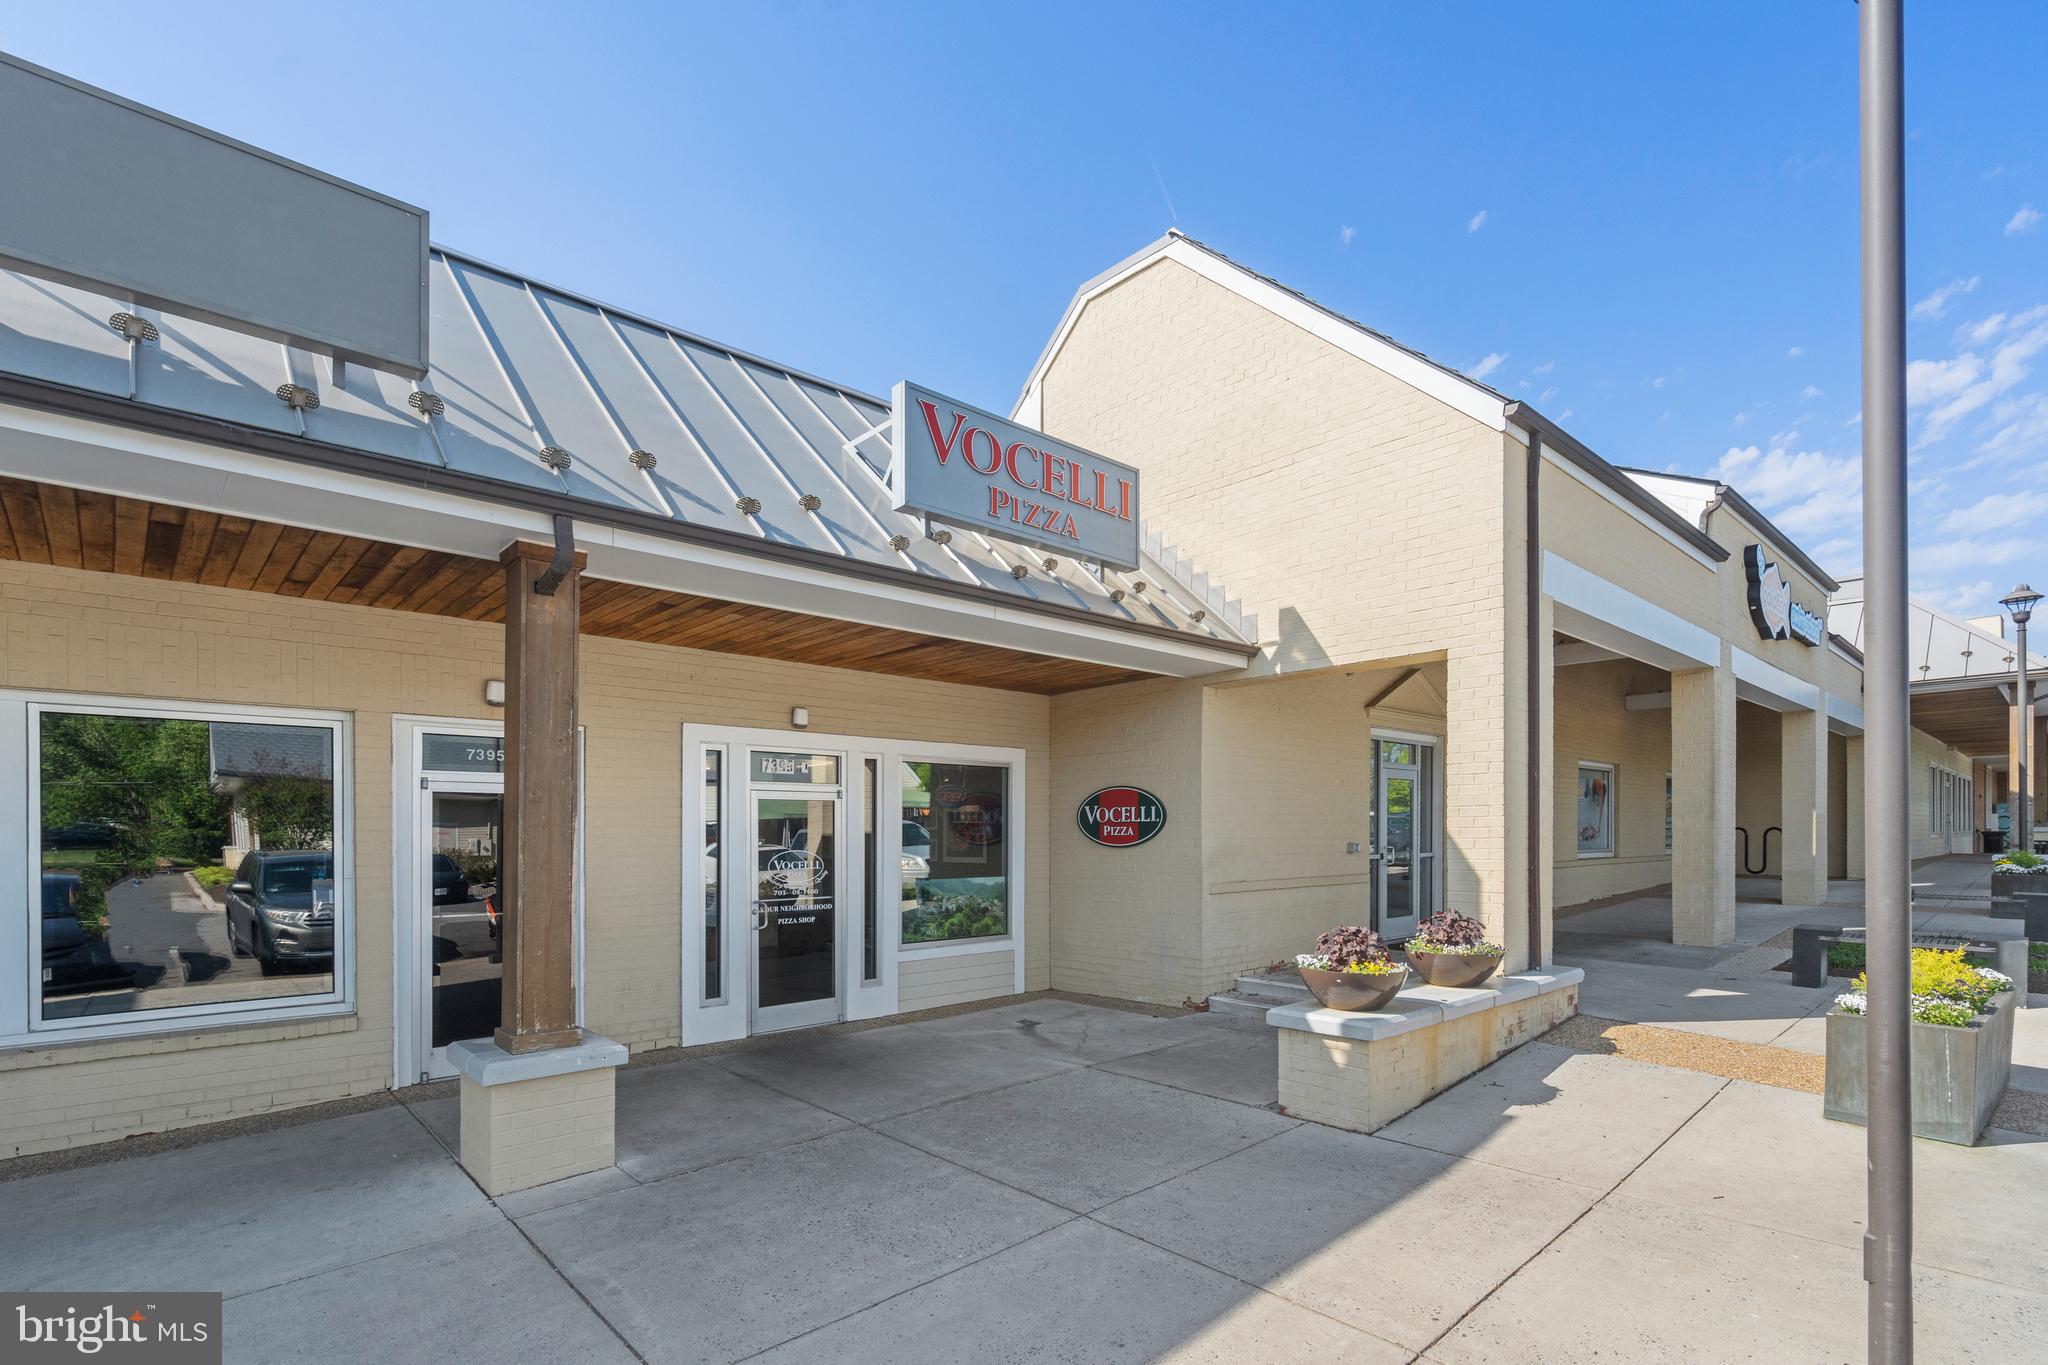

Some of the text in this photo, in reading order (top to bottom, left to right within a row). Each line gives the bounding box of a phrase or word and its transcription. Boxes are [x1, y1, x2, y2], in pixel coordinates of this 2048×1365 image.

[918, 398, 1132, 521] VOCELLI
[989, 485, 1080, 540] PIZZA
[466, 749, 504, 761] 7395
[1103, 826, 1134, 836] PIZZA
